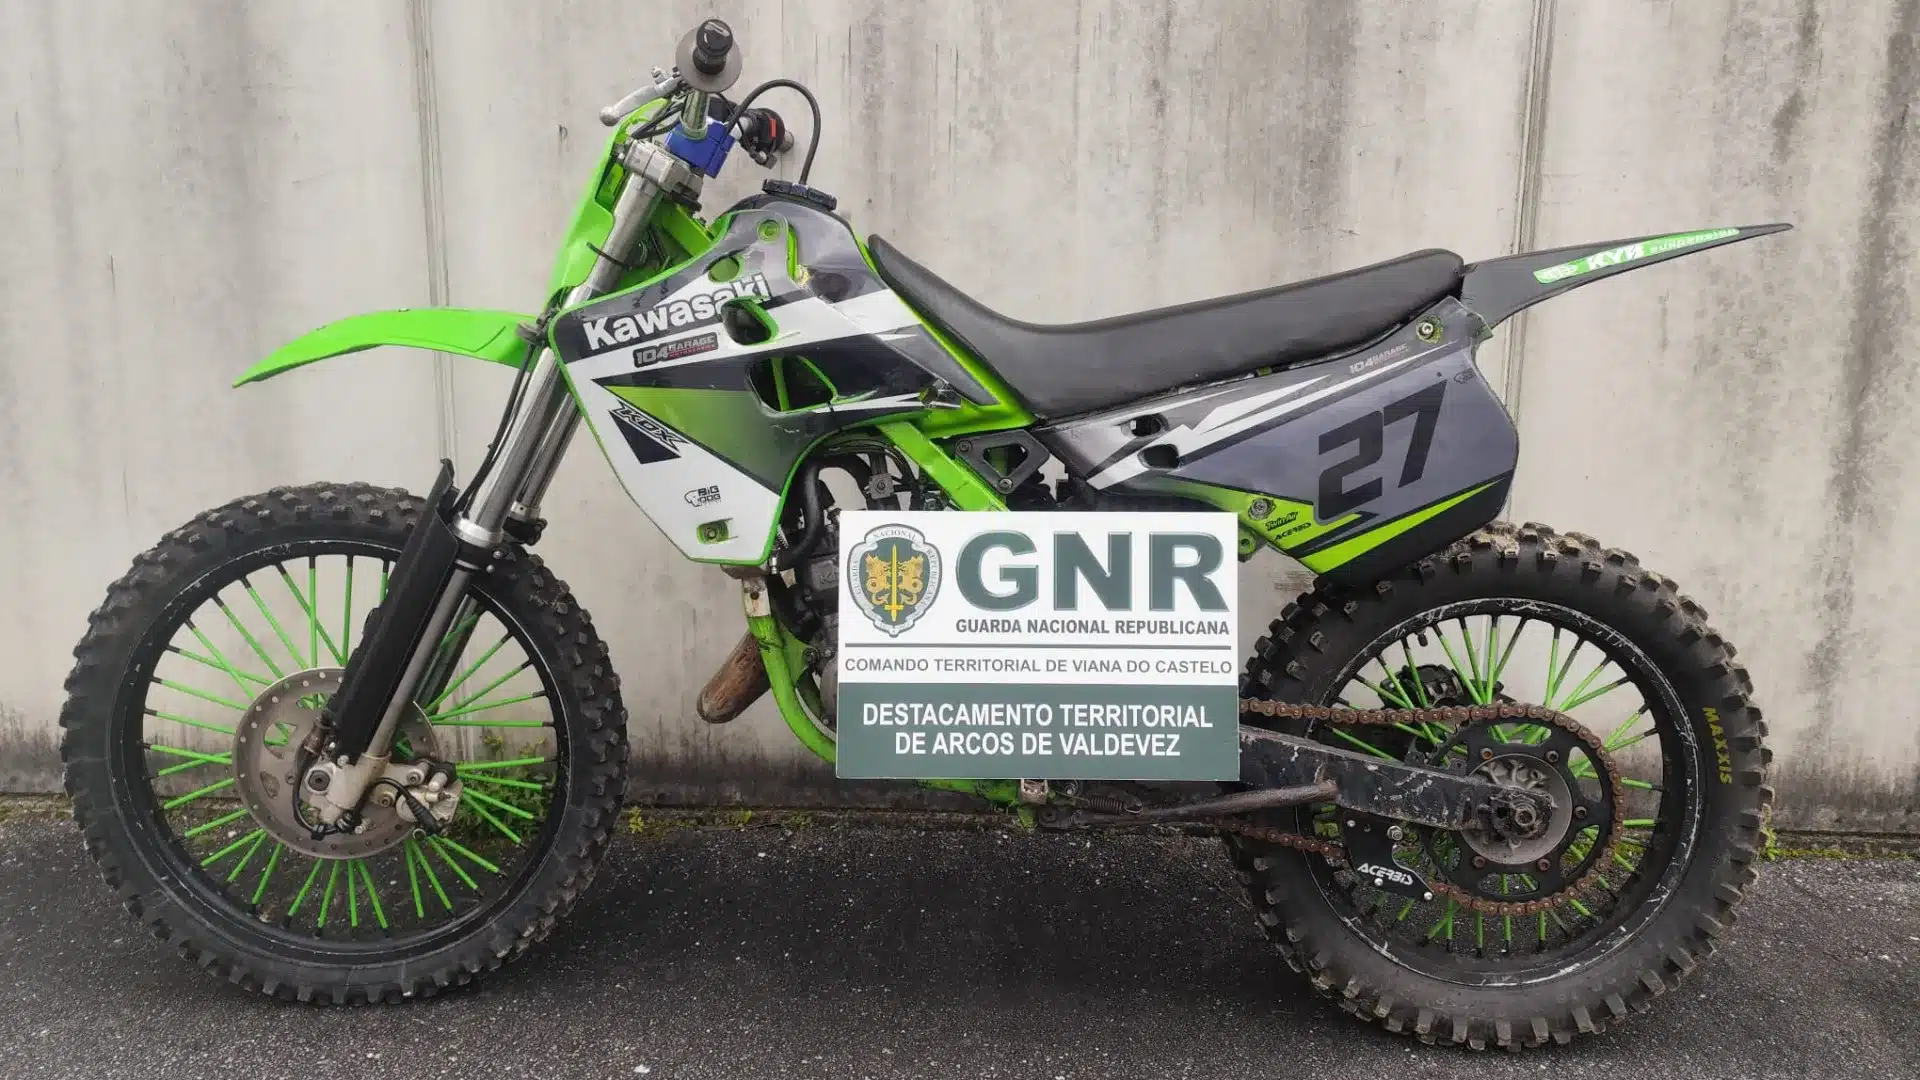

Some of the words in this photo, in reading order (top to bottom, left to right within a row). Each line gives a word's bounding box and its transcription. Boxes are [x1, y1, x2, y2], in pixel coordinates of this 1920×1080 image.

[583, 272, 770, 350] Kawasaki
[636, 346, 667, 364] 104
[1318, 379, 1448, 521] 27
[956, 530, 1229, 612] GNR
[956, 619, 1022, 634] GUARDA
[1027, 619, 1109, 634] NACIONAL
[1115, 620, 1229, 635] REPUBLICANA
[845, 658, 929, 672] COMANDO
[934, 659, 1040, 672] TERRITORIAL
[1045, 659, 1068, 672] DE
[1073, 660, 1123, 673] VIANA
[1127, 660, 1151, 673] DO
[1155, 660, 1232, 674] CASTELO
[863, 703, 1053, 727] DESTACAMENTO
[1060, 704, 1213, 728] TERRITORIAL
[895, 732, 926, 755] DE
[932, 732, 1014, 756] ARCOS
[1022, 733, 1052, 756] DE
[1059, 734, 1180, 757] VALDEVEZ
[1702, 707, 1732, 784] MAXXIS
[1357, 862, 1413, 886] ACERBIS
